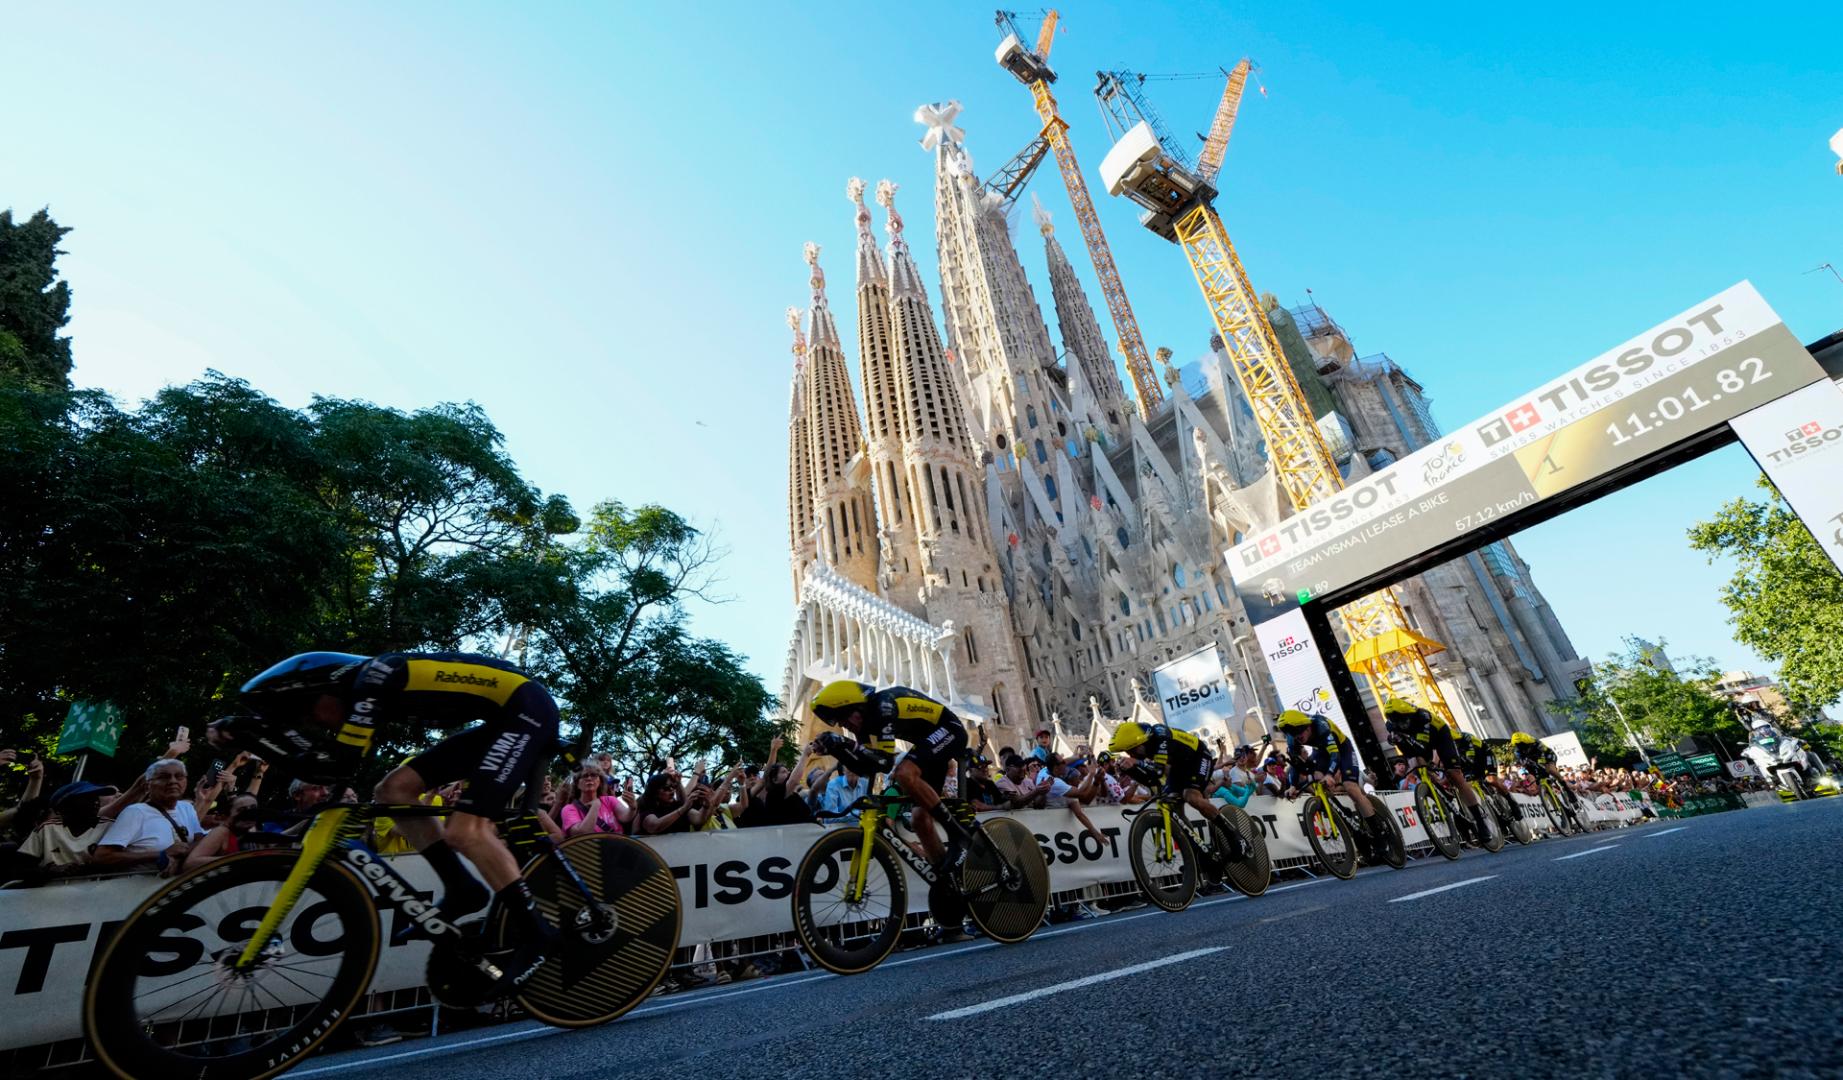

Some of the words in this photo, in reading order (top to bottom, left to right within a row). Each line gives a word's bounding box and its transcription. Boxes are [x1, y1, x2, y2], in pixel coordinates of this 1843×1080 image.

[1538, 304, 1724, 413] TISSOT
[1489, 432, 1537, 458] SWISS
[1544, 390, 1625, 431] WATCHES
[1633, 358, 1690, 388] SINCE
[1699, 329, 1746, 356] 1853
[1605, 357, 1773, 446] 11:01.82
[1766, 425, 1843, 463] TISSO
[1280, 471, 1398, 544] TISSOT
[1455, 507, 1497, 532] 57.12
[1499, 492, 1535, 516] km/h
[1290, 550, 1322, 574] TEAM
[1323, 535, 1361, 560] VISMA
[1367, 512, 1406, 538] LEASE
[1408, 508, 1420, 518] A
[1419, 493, 1450, 512] BIKE
[1269, 640, 1310, 662] TISSOT
[434, 670, 500, 688] Rabobank
[1166, 679, 1220, 711] TISSOT
[479, 732, 521, 771] VISMA
